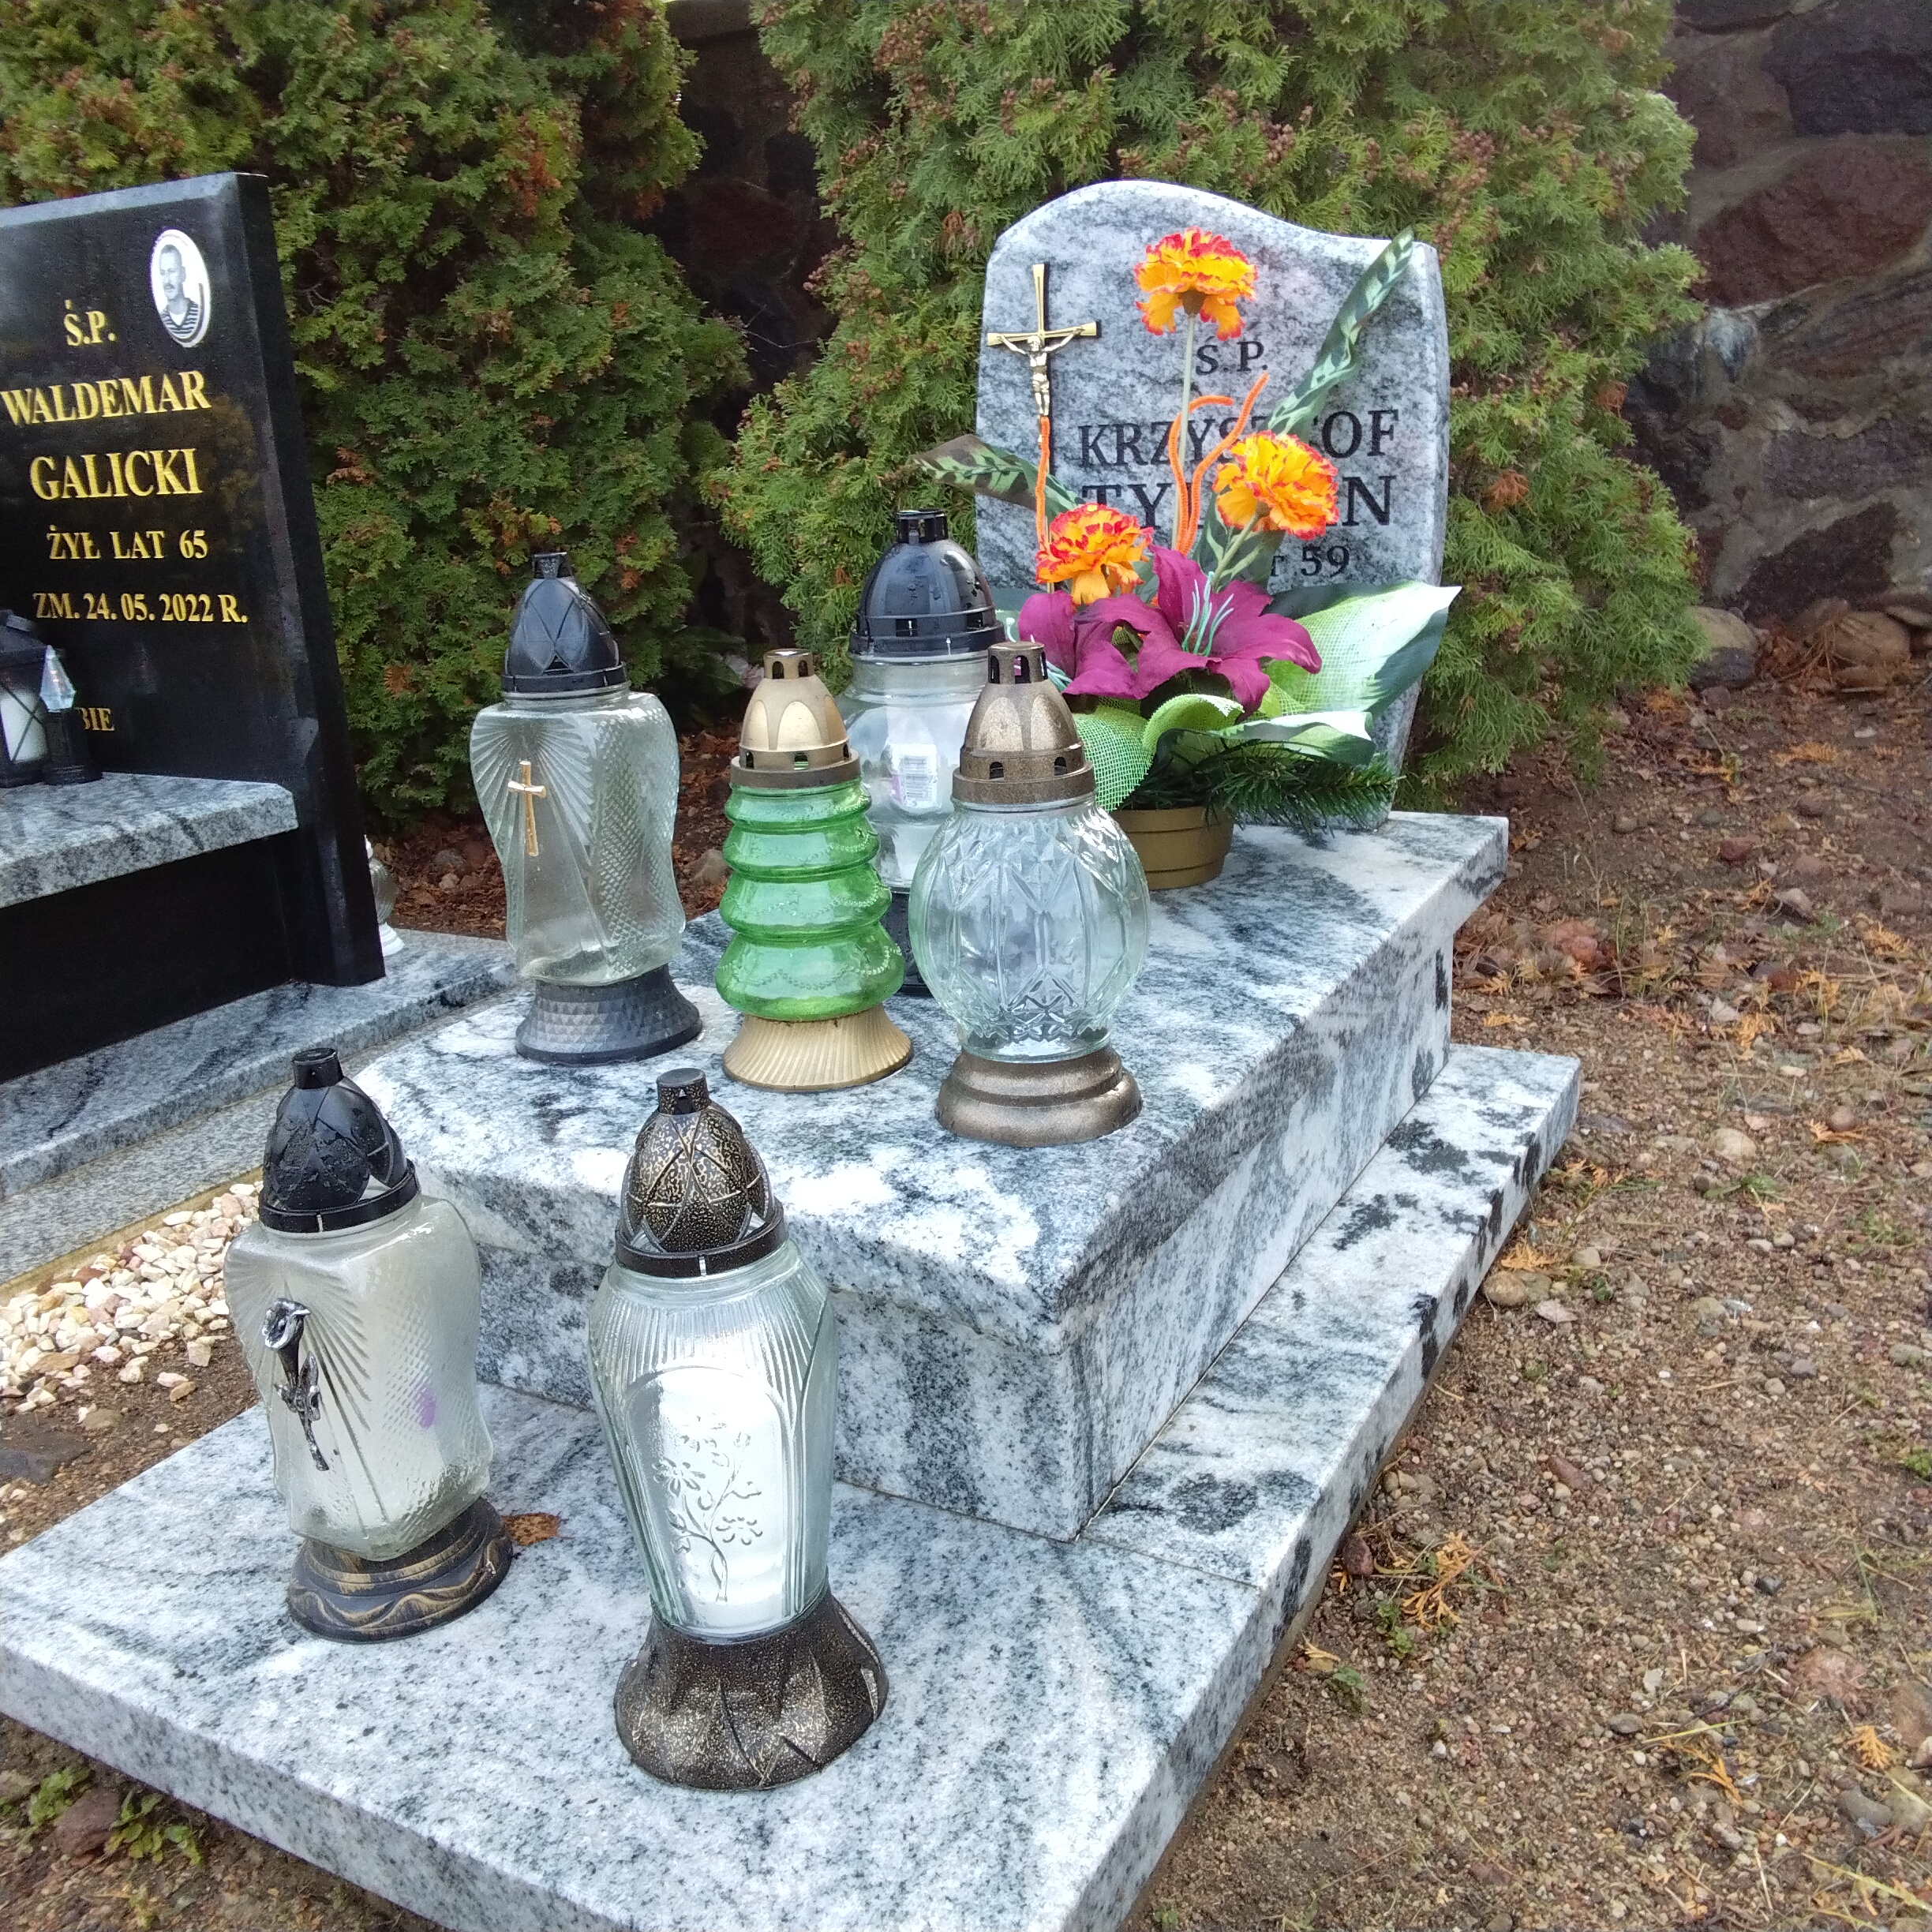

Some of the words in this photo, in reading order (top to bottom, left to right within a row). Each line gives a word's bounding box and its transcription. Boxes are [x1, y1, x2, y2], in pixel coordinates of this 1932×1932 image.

[0, 370, 212, 425] WALDEMAR
[29, 448, 203, 500] GALICKI
[47, 525, 101, 560] ŻYŁ
[109, 530, 165, 559] LAT
[179, 530, 208, 559] 65
[1301, 545, 1350, 578] 59
[32, 593, 80, 620] ZM.
[159, 593, 213, 622] 2022
[217, 594, 249, 623] R.
